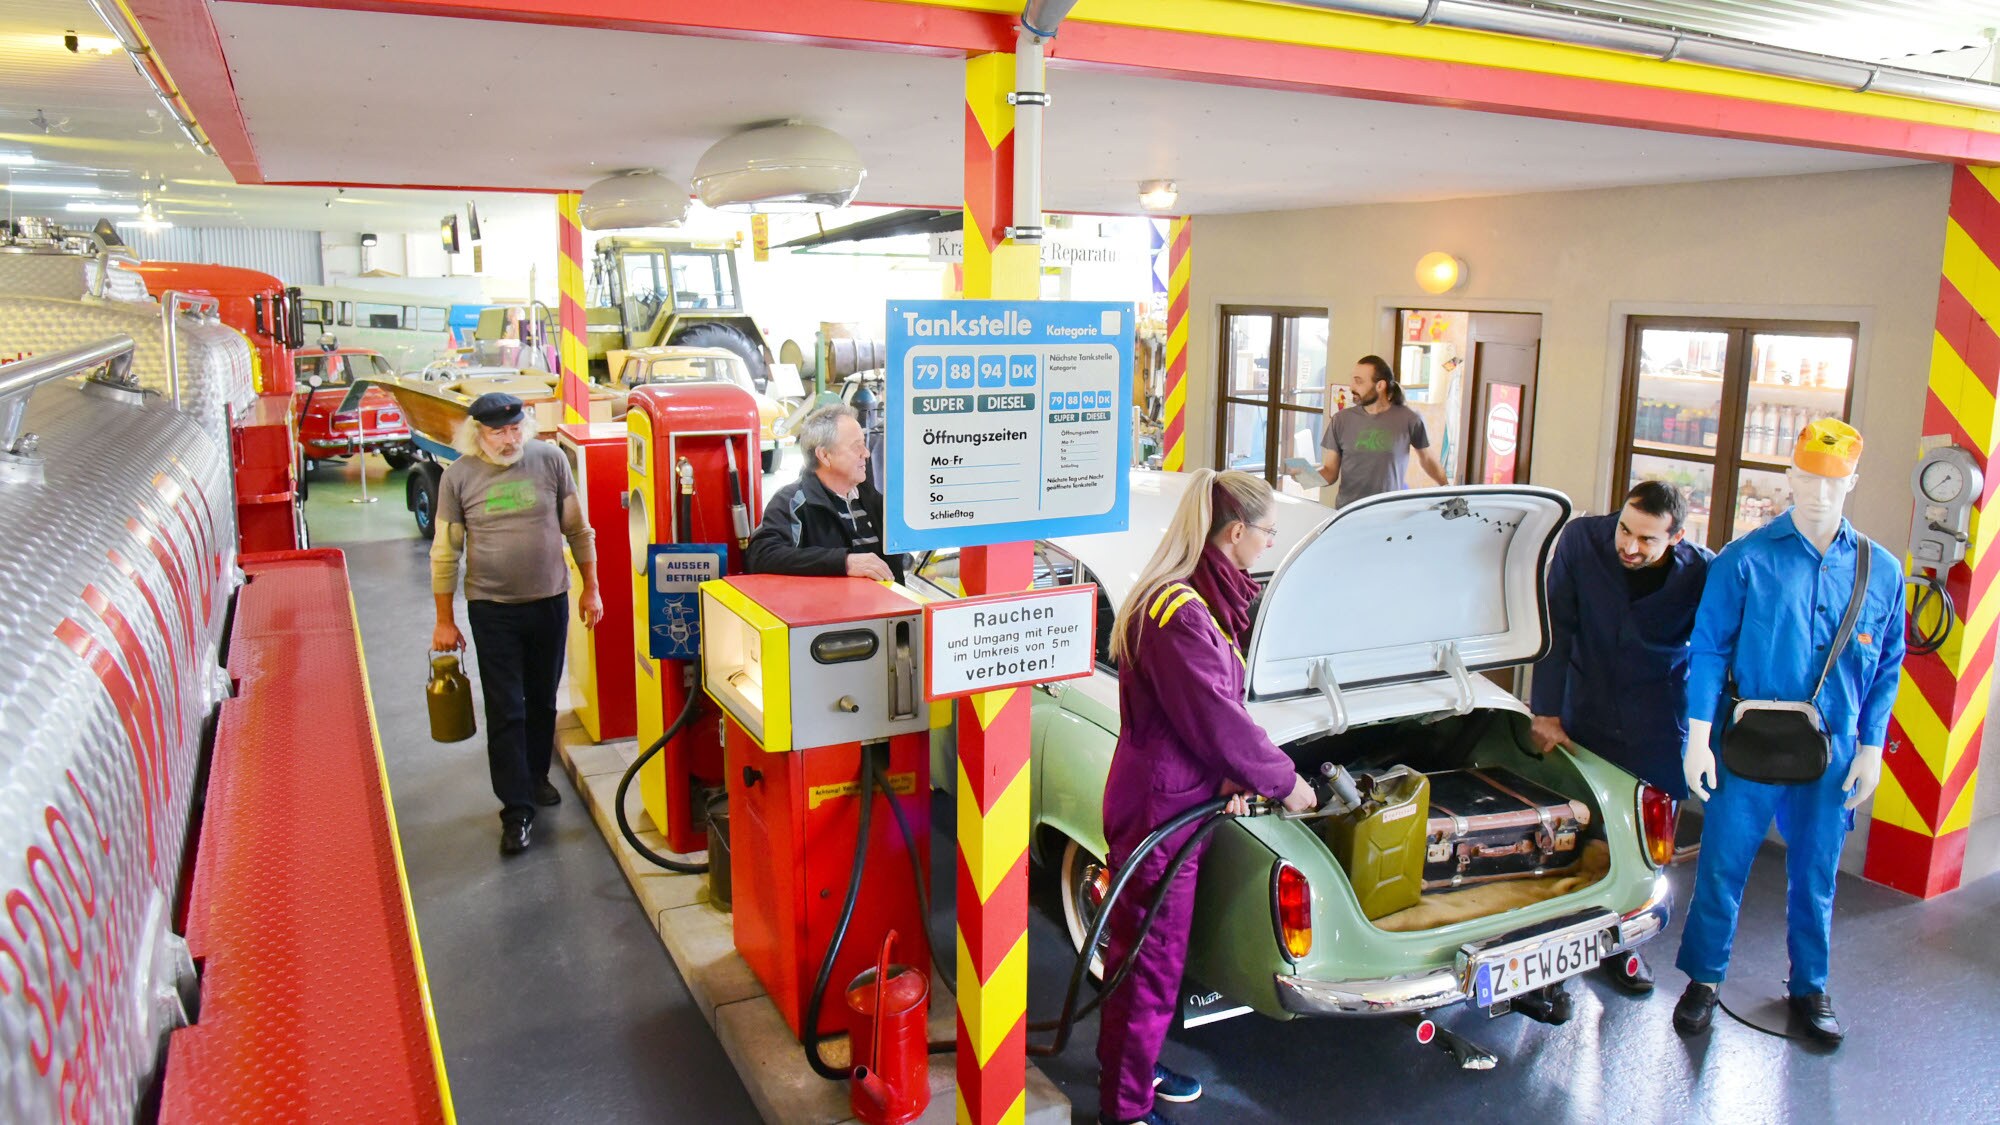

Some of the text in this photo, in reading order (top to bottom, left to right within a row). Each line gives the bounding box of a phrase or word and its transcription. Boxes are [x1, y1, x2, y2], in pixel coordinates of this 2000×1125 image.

[937, 237, 963, 256] Kra
[1052, 242, 1117, 265] Reparatu
[903, 310, 1032, 337] Tankstelle
[1046, 324, 1098, 339] Kategorie
[1049, 352, 1113, 362] Nächste Tankstelle
[917, 363, 1034, 380] 79 88 94 DK
[922, 395, 1027, 412] SUPER DIESEL
[1051, 395, 1110, 406] 79 88 94 DK
[1053, 412, 1107, 423] SUPER DIESEL
[923, 428, 1028, 446] Öffnungszeiten
[929, 474, 944, 485] Sa
[929, 492, 944, 503] So
[930, 510, 975, 521] Schließtag
[667, 561, 710, 570] AUSSER
[666, 574, 711, 583] BETRIEB
[974, 606, 1054, 628] Rauchen
[947, 624, 1079, 649] und Umgang mit Feuer
[953, 652, 968, 662] im
[973, 645, 1019, 659] Umkreis
[1025, 642, 1045, 653] von
[966, 654, 1056, 681] verboten!
